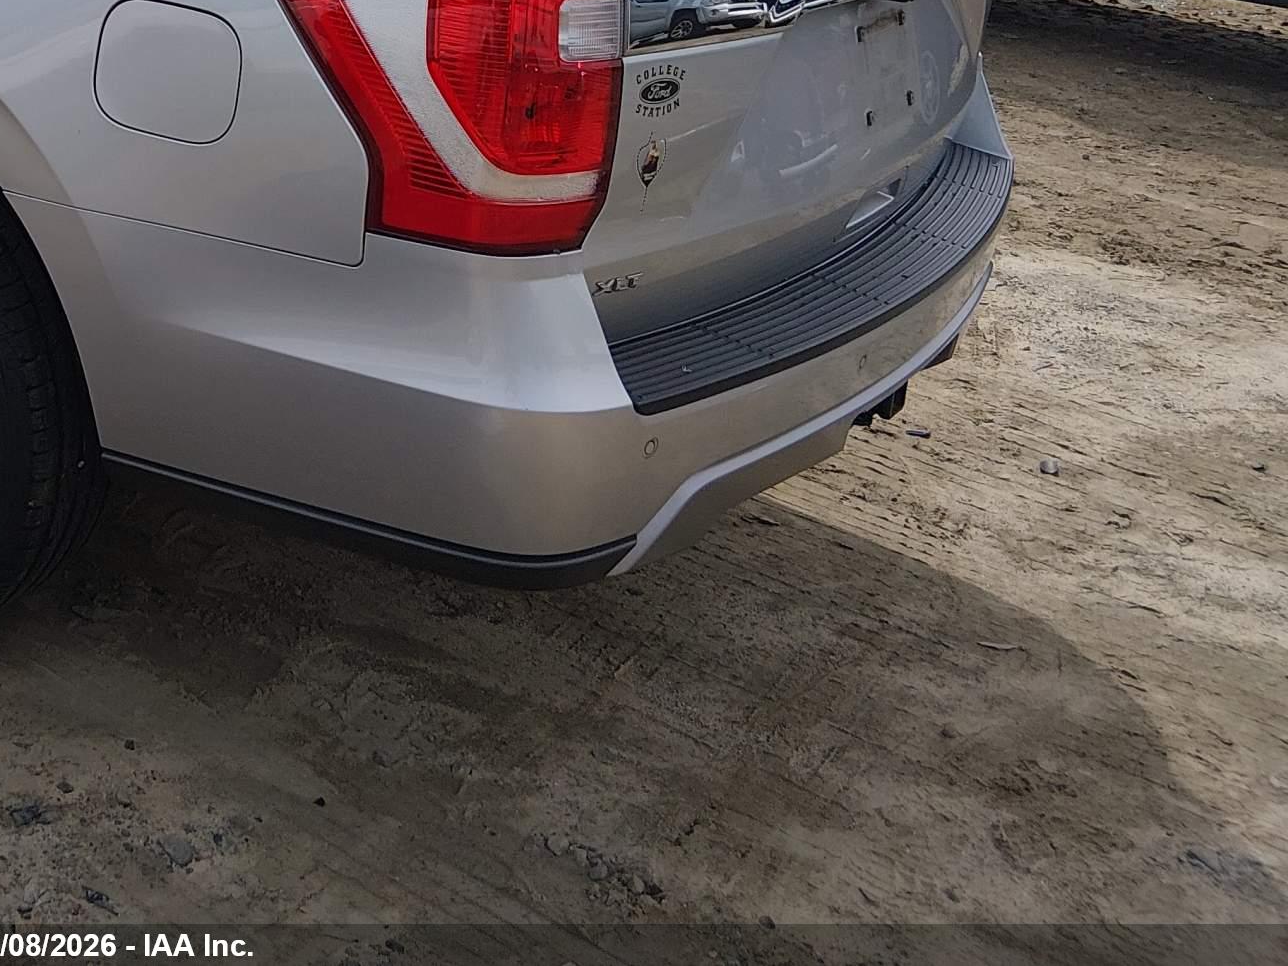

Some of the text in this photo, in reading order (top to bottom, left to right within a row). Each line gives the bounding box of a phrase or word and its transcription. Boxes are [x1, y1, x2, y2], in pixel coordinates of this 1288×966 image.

[636, 64, 686, 85] COLLEGE
[647, 83, 673, 99] Ford
[635, 98, 680, 117] STATION
[591, 272, 644, 296] XLT
